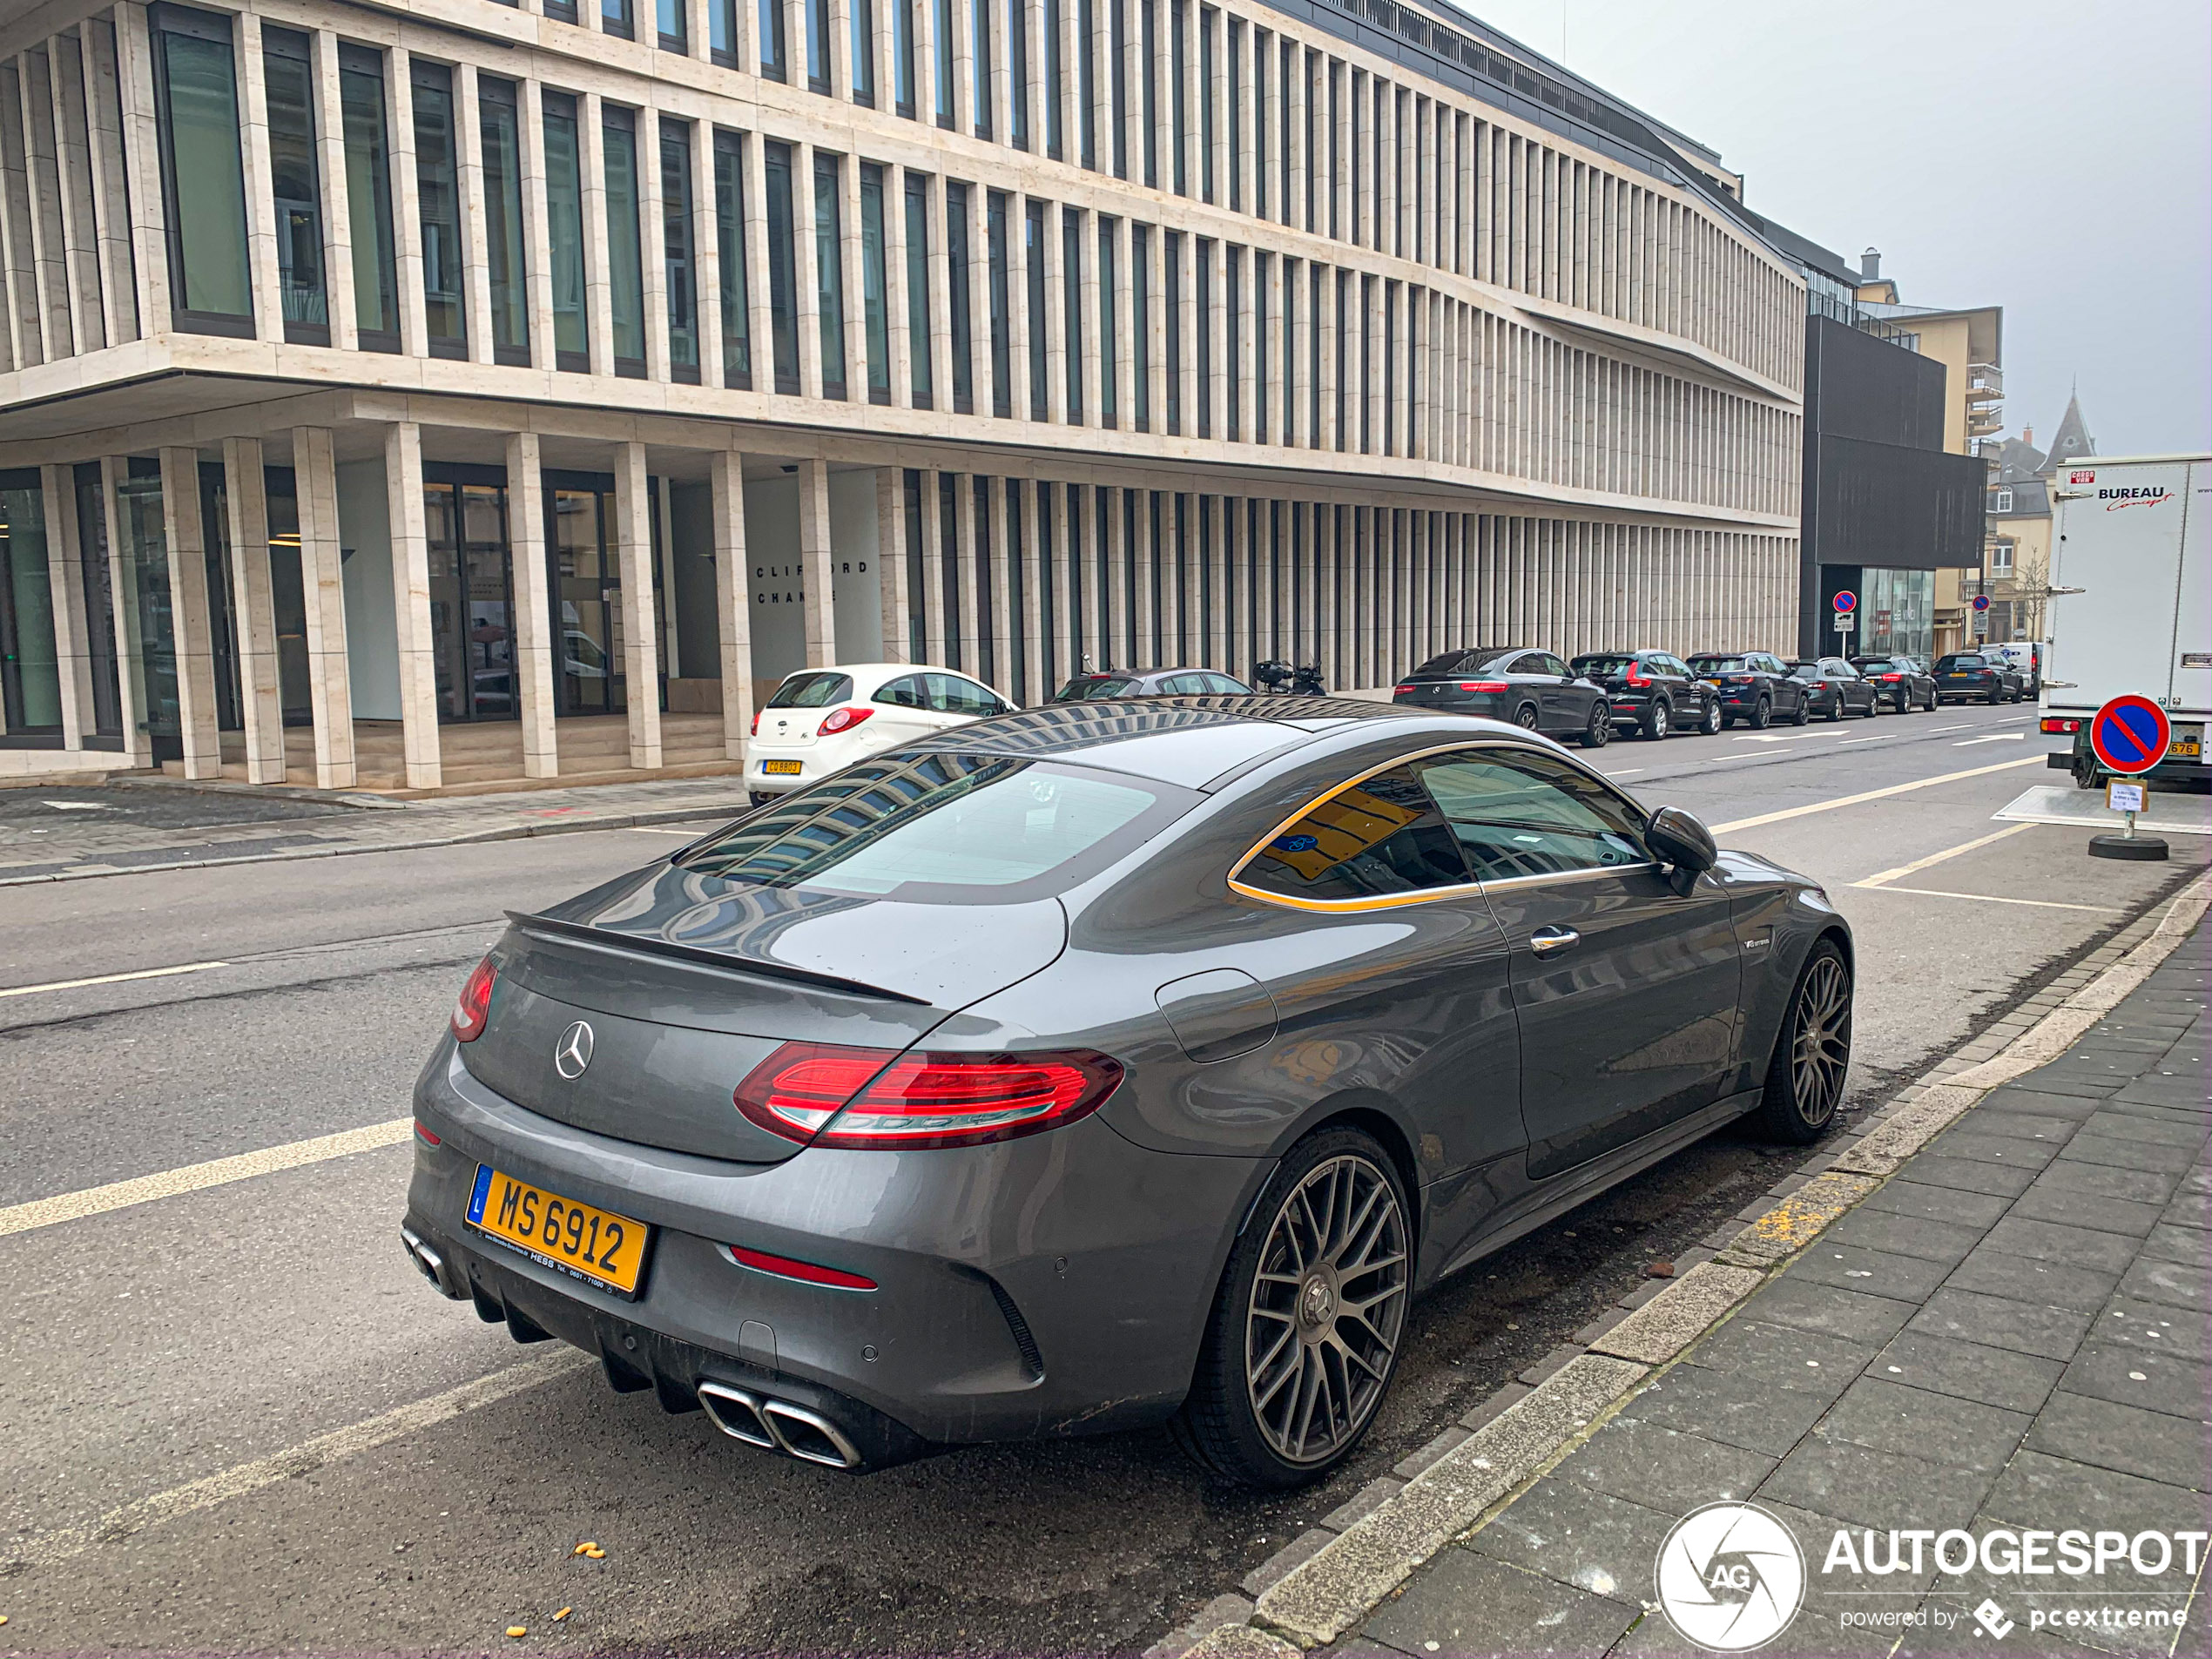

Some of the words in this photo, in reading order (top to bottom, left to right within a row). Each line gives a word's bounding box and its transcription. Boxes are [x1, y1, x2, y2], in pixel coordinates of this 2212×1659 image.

[2099, 487, 2164, 499] BUREAU
[2107, 493, 2175, 511] Concept
[757, 562, 867, 577] CLIFRD
[474, 1197, 480, 1213] L
[497, 1181, 539, 1237] MS
[543, 1200, 624, 1274] 6912
[530, 1251, 555, 1269] HESS
[557, 1264, 566, 1273] Tel.
